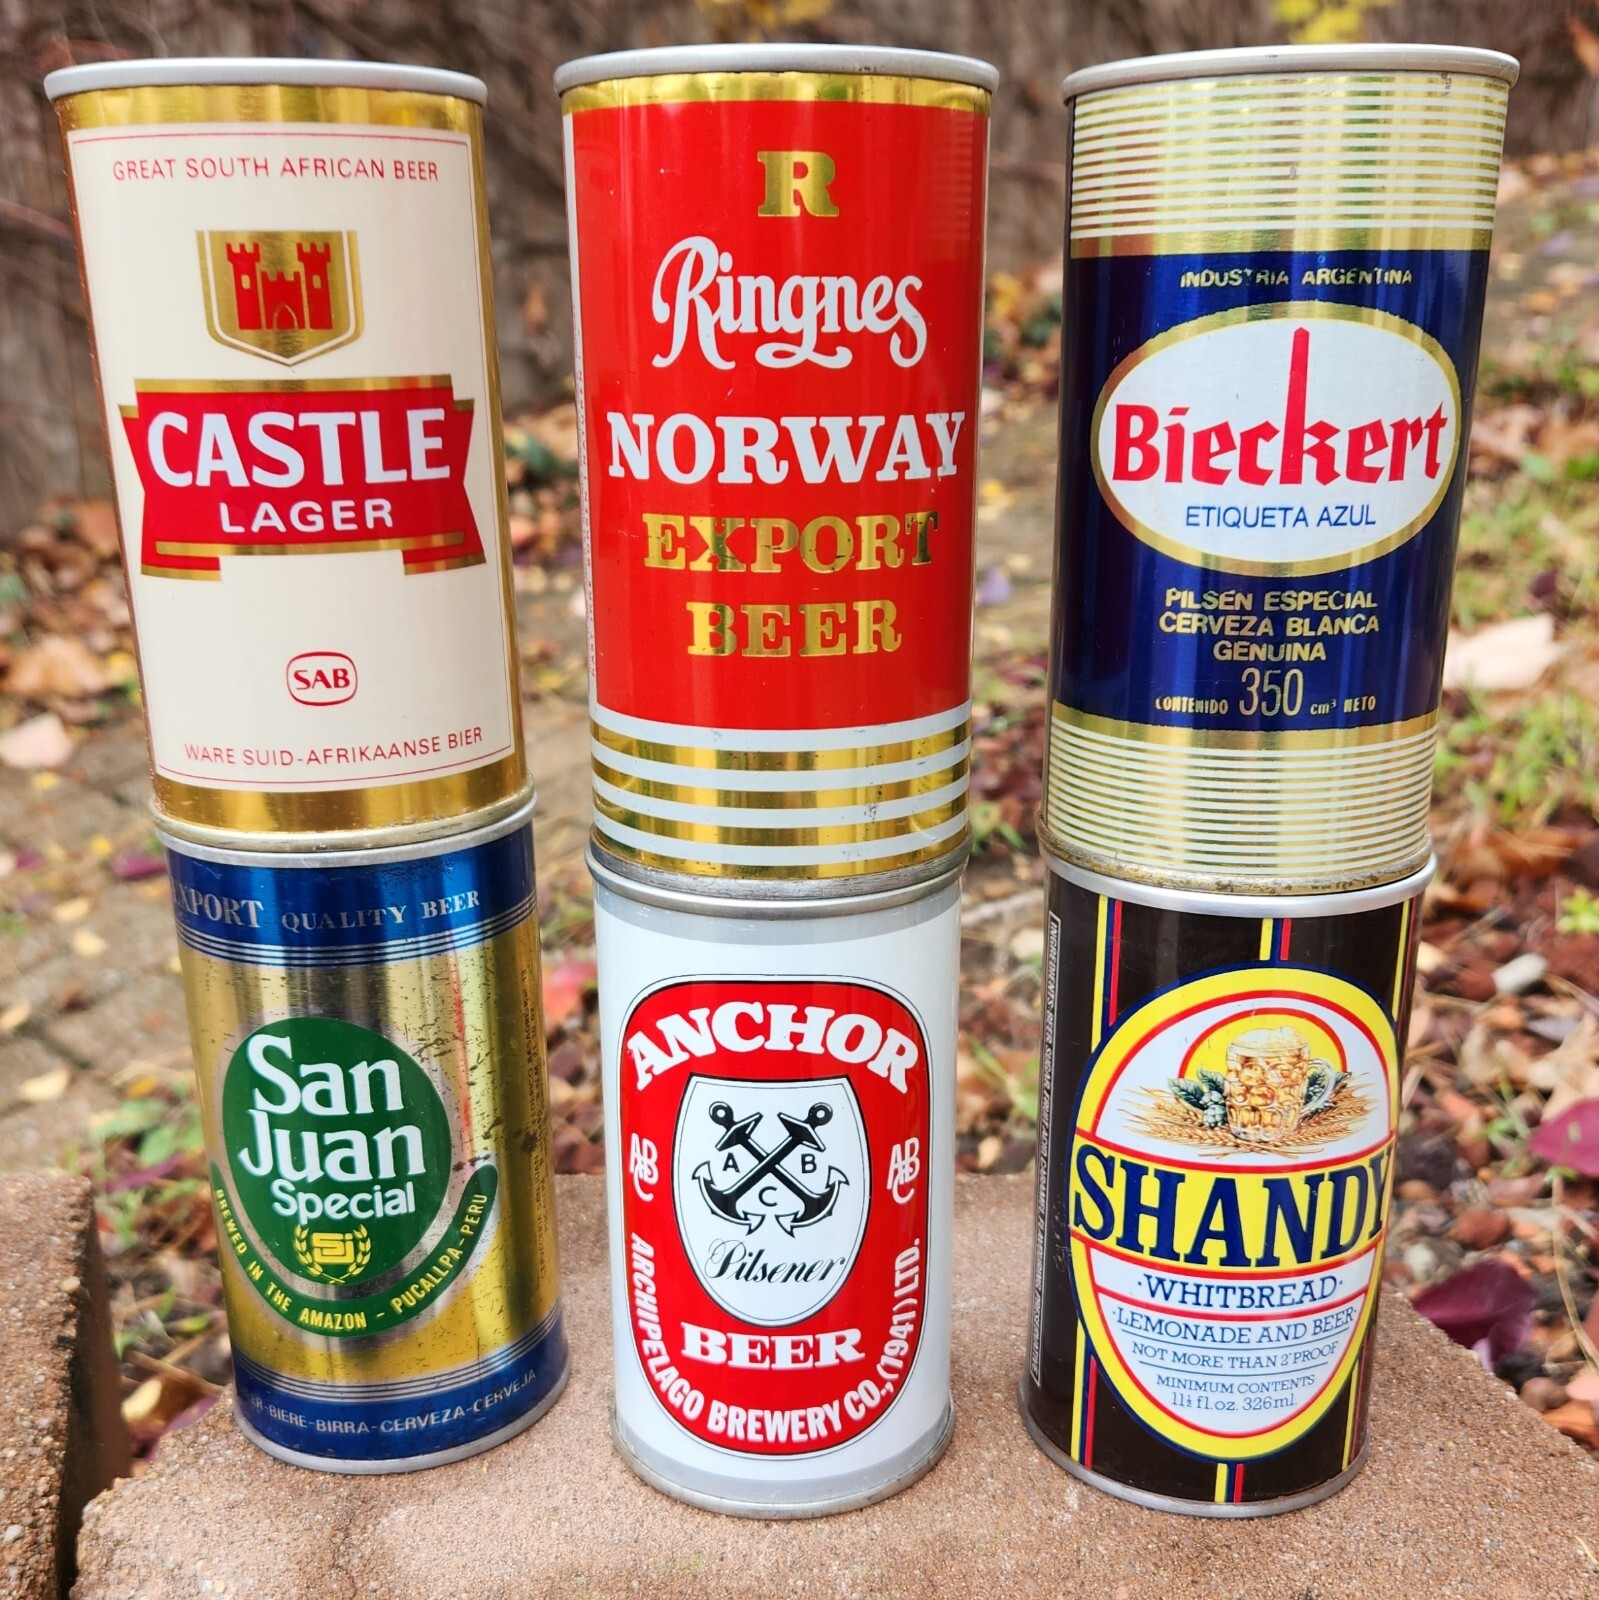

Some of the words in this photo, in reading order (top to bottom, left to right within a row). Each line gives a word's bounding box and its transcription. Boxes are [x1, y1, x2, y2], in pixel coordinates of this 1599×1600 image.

[113, 158, 175, 182] GREAT
[186, 157, 269, 178] SOUTH
[280, 157, 385, 179] AFRICAN
[394, 160, 439, 182] BEER
[757, 151, 839, 217] R
[1301, 268, 1413, 287] ARGENTINA
[651, 236, 927, 370] Ringnes
[1112, 327, 1449, 486] Bieckert
[147, 407, 450, 488] CASTLE
[607, 411, 965, 485] NORWAY
[219, 498, 394, 534] LAGER
[1185, 506, 1308, 529] ETIQUETA
[1317, 504, 1376, 528] AZUL
[642, 510, 938, 574] EXPORT
[1165, 587, 1253, 611] PILSEN
[1264, 590, 1378, 611] ESPECIAL
[686, 600, 902, 657] BEER
[1159, 611, 1274, 636] CERVEZA
[1286, 613, 1379, 637] BLANCA
[1213, 639, 1327, 662] GENUINA
[293, 667, 351, 690] SAB
[1155, 696, 1229, 715] CONTENIDO
[1239, 667, 1304, 717] 350
[1343, 695, 1376, 714] NETO
[184, 743, 236, 764] WARE
[243, 735, 441, 767] SUID-AFRIKAANSE
[448, 726, 482, 750] BIER
[282, 905, 406, 933] QUALITY
[421, 890, 480, 919] BEER
[627, 1001, 919, 1094] ANCHOR
[246, 1034, 404, 1116] San
[238, 1108, 427, 1182] Juan
[722, 1153, 741, 1174] A
[801, 1153, 818, 1174] B
[272, 1179, 416, 1225] Special
[758, 1186, 778, 1207] C
[1073, 1143, 1393, 1268] SHANDY
[215, 1189, 248, 1254] BREWED
[248, 1260, 264, 1281] IN
[265, 1282, 293, 1312] THE
[300, 1307, 368, 1330] AMAZON
[704, 1238, 846, 1284] Pilsener
[631, 1232, 705, 1421] ARCHIPELAGO
[707, 1399, 842, 1444] BREWERY
[893, 1237, 921, 1298] LTD.
[680, 1321, 866, 1371] BEER
[1132, 1341, 1168, 1361] NOT
[1172, 1350, 1224, 1368] MORE
[1227, 1354, 1278, 1369] THAN
[1256, 1322, 1308, 1343] AND
[1156, 1374, 1235, 1394] MINIMUM
[1237, 1374, 1315, 1394] CONTENTS
